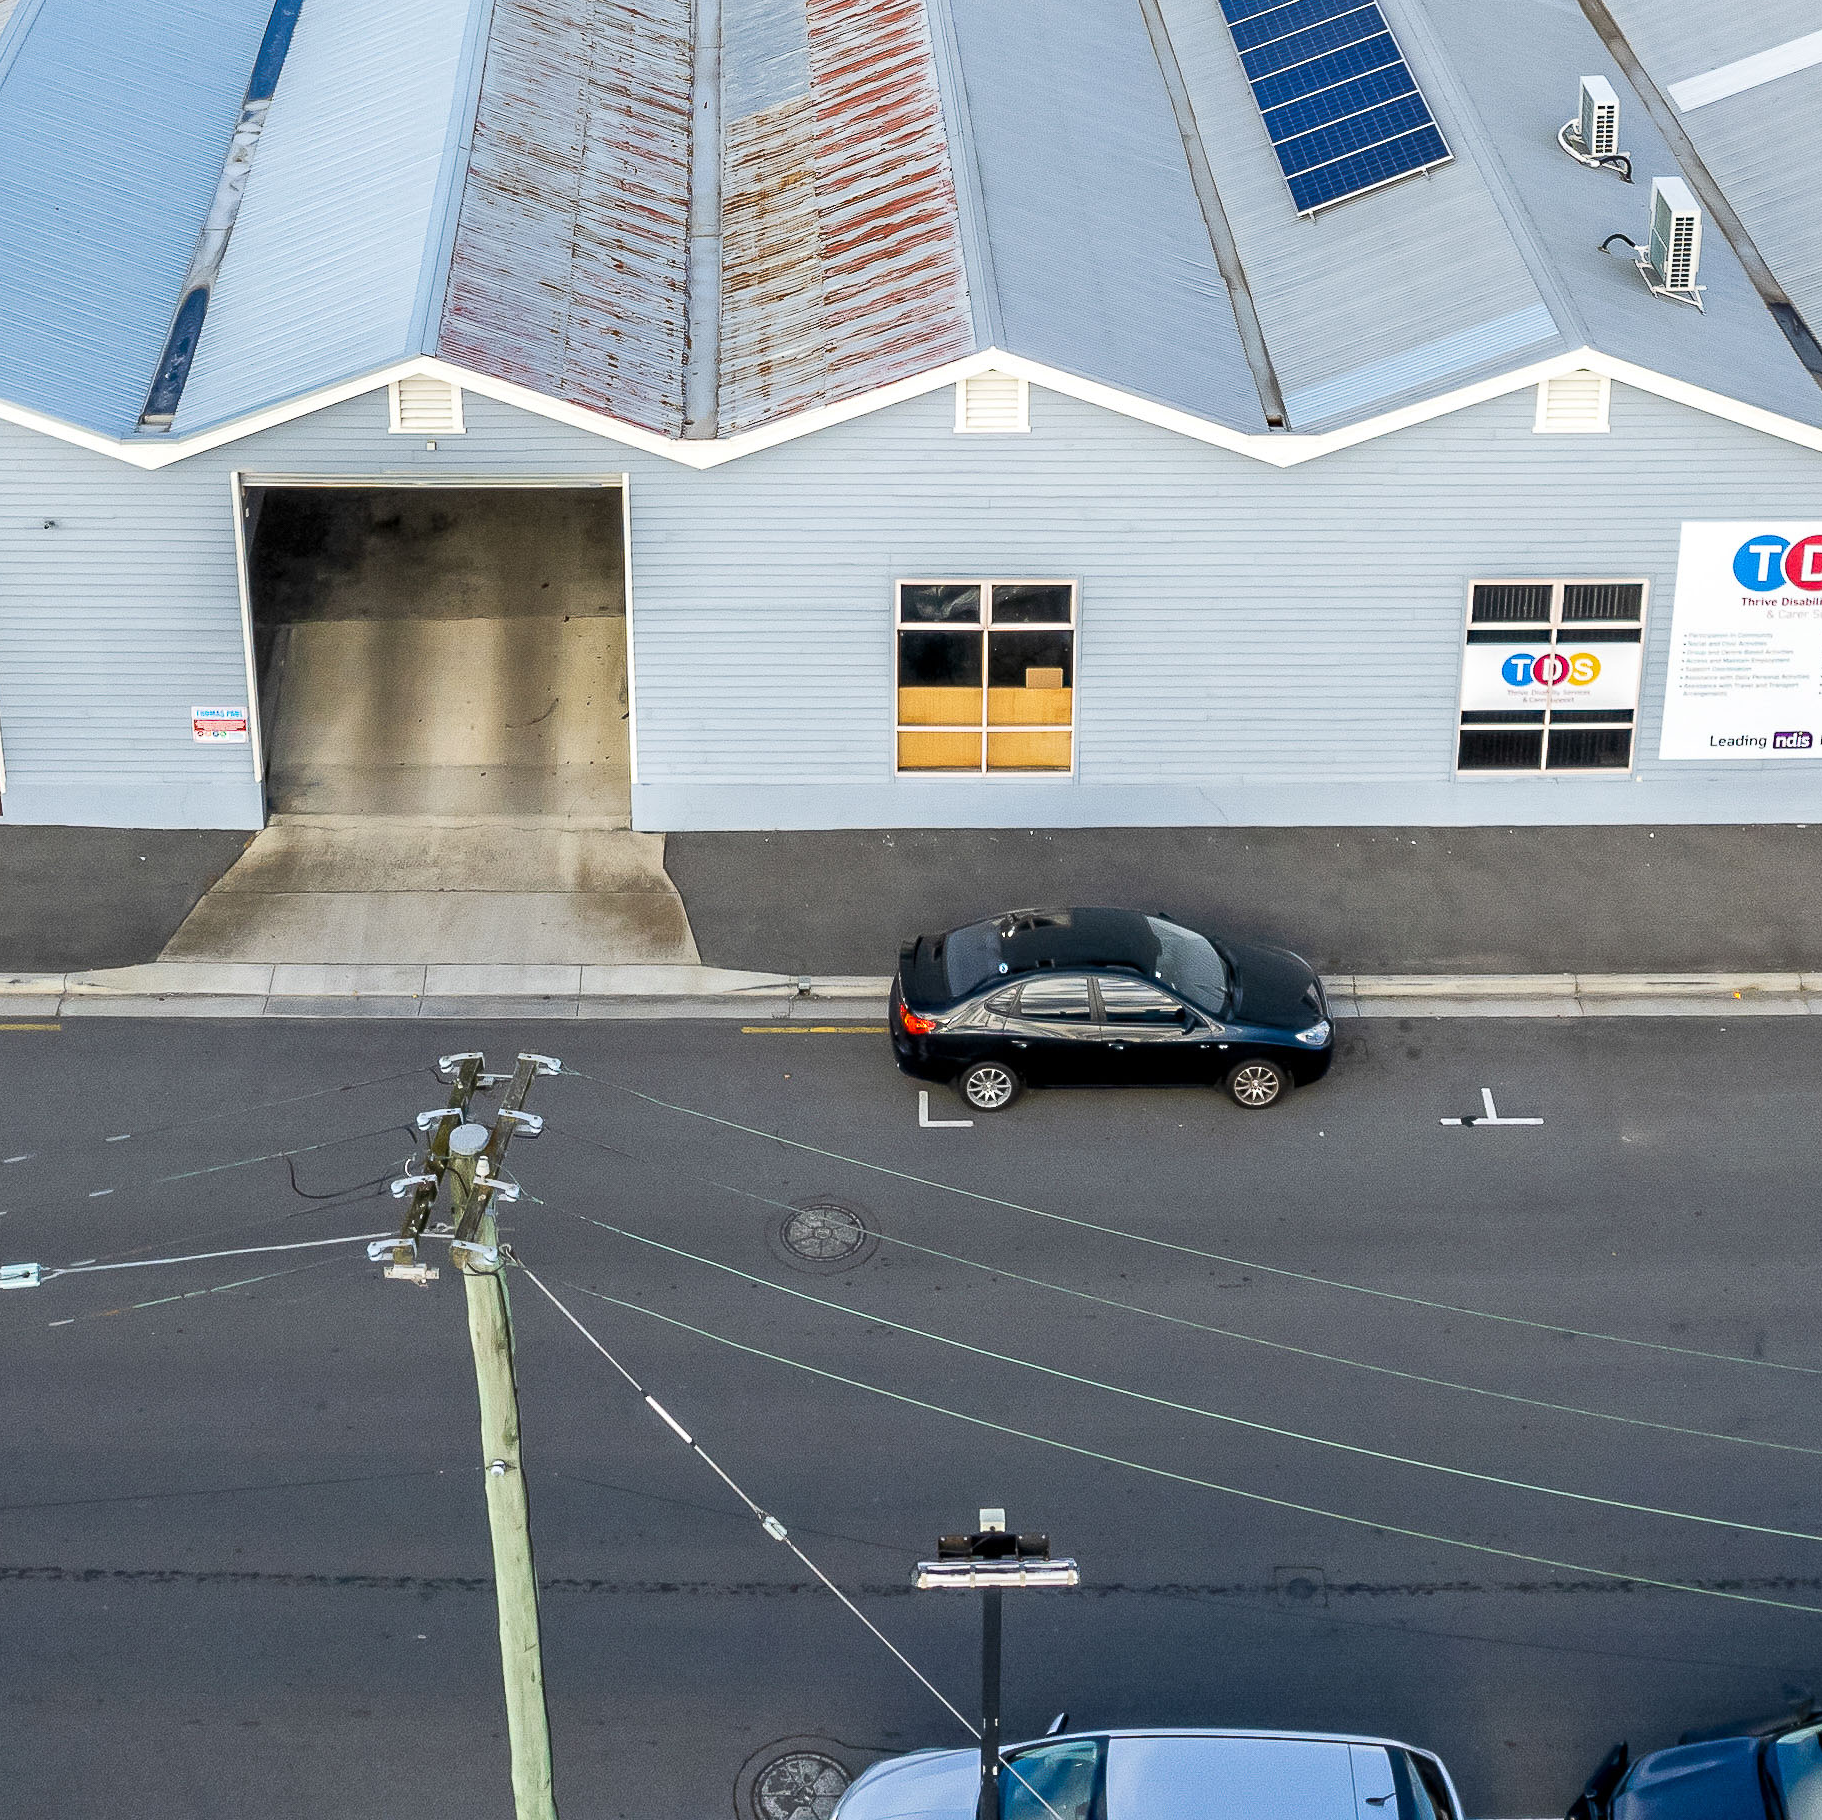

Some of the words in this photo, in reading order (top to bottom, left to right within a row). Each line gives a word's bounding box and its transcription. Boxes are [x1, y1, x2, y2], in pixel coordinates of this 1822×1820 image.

[1741, 596, 1778, 607] Thrive
[1765, 608, 1775, 619] &
[1777, 608, 1807, 619] Carer
[1510, 658, 1594, 682] TDS
[1709, 734, 1768, 750] Leading
[1775, 731, 1811, 748] ndis
